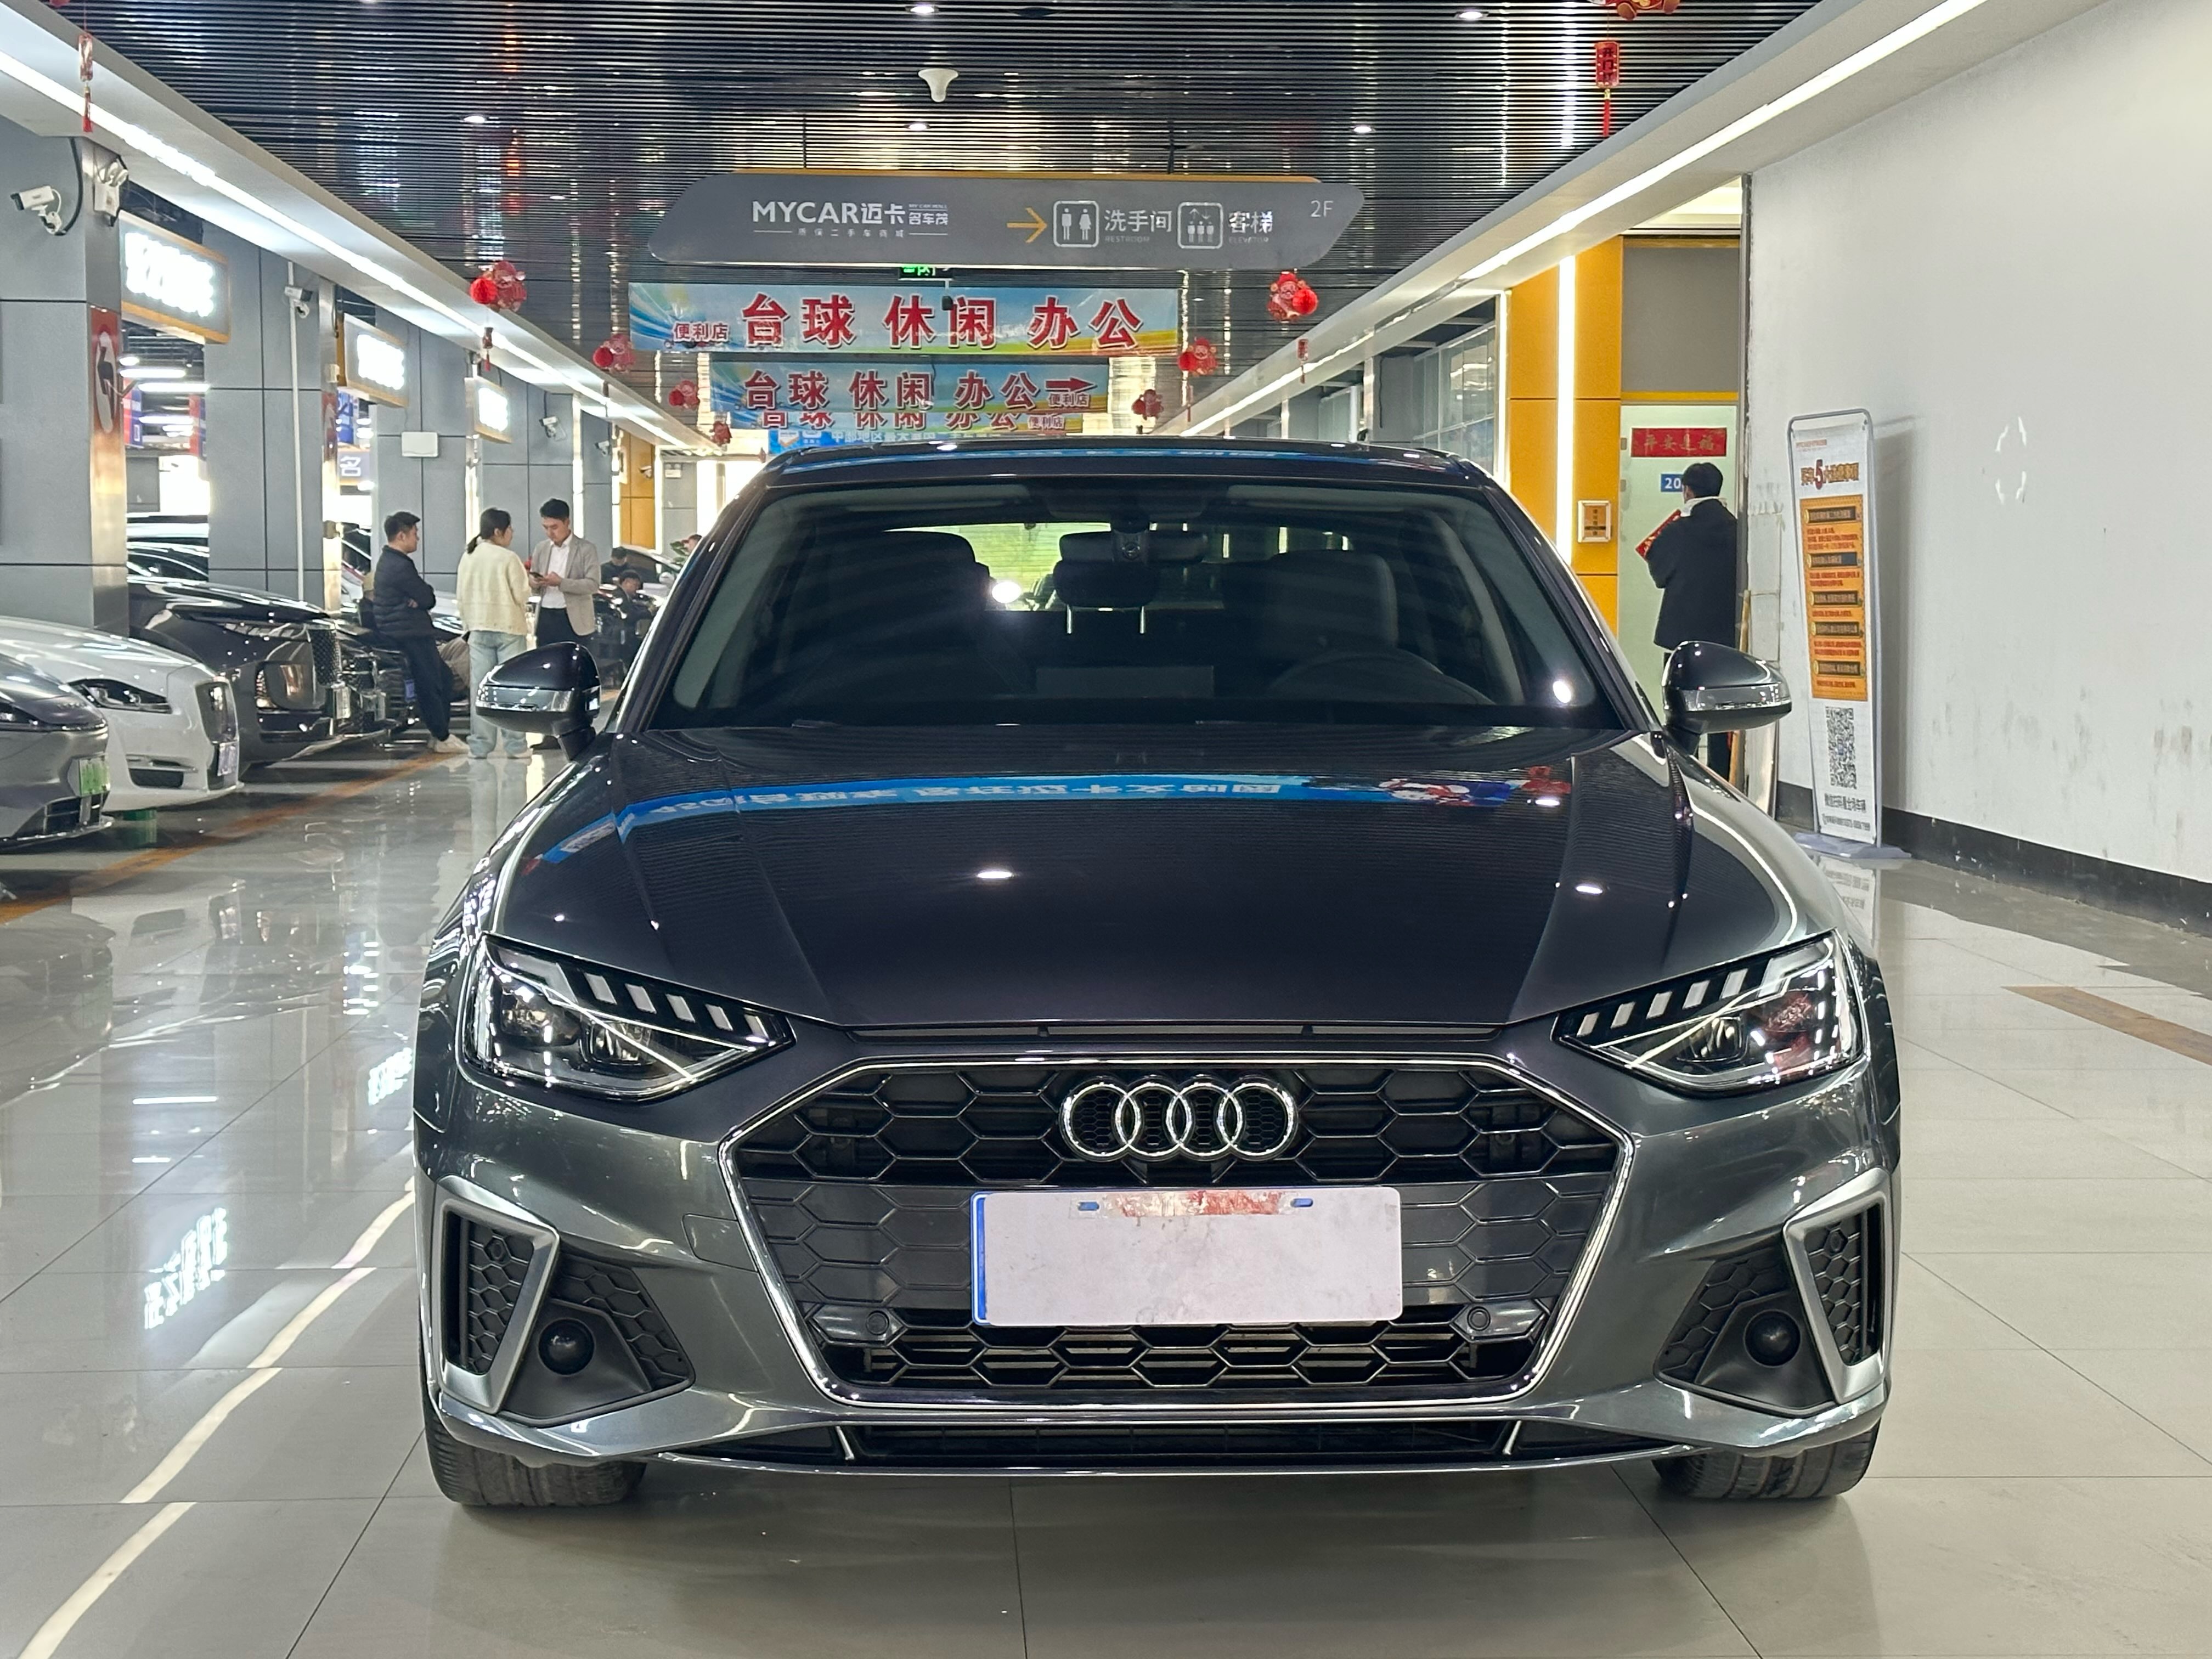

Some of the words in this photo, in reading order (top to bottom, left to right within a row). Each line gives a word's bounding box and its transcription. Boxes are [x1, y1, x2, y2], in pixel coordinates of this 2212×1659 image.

[909, 212, 948, 225] 名车茂
[1311, 200, 1334, 217] 2F
[1104, 210, 1172, 233] 洗手间
[1229, 211, 1273, 234] 客梯
[742, 292, 855, 348] 台球
[883, 294, 997, 349] 休闲
[1027, 295, 1143, 349] 办公
[674, 321, 729, 343] 便利店
[745, 370, 829, 410] 台球
[848, 370, 931, 410] 休闲
[953, 369, 1040, 410] 办公
[1048, 393, 1090, 408] 便利店
[1664, 478, 1682, 489] 20
